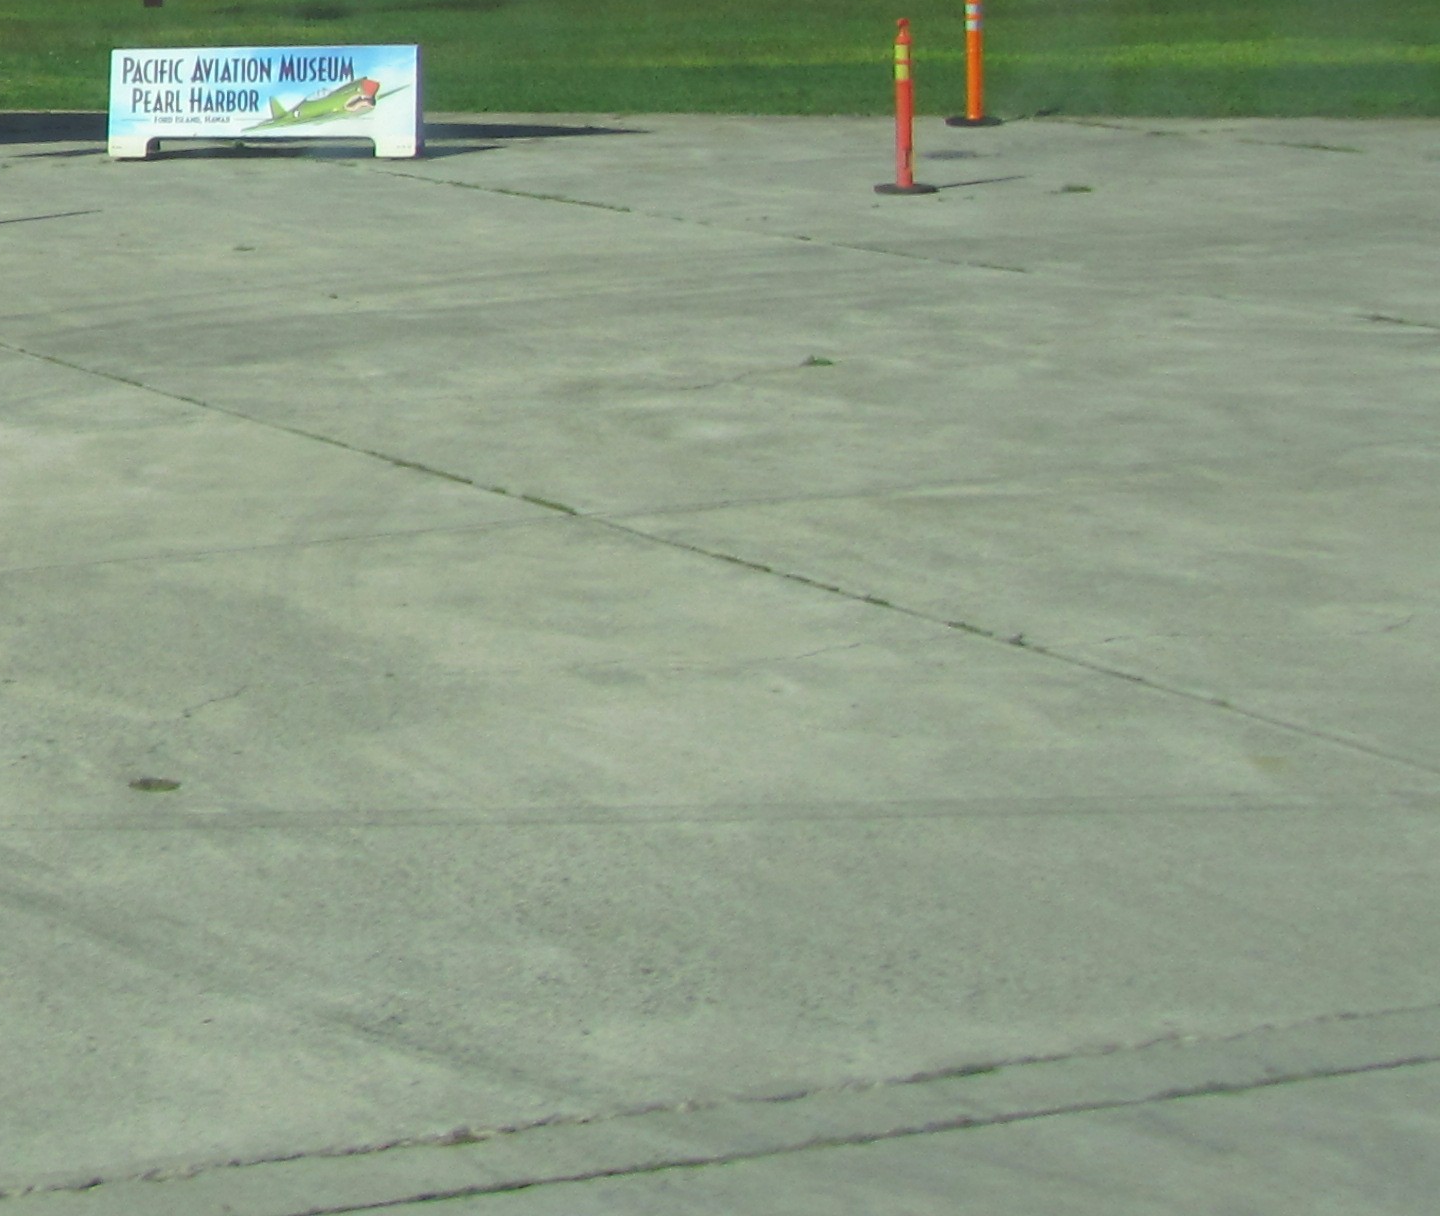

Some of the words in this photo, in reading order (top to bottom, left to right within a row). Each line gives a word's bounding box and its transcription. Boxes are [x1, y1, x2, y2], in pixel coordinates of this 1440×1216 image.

[122, 57, 184, 84] PACIFIC
[191, 55, 271, 83] AVIATION
[279, 54, 355, 82] MUSEUM
[131, 88, 183, 113] PEARL
[189, 87, 259, 113] HARBOR
